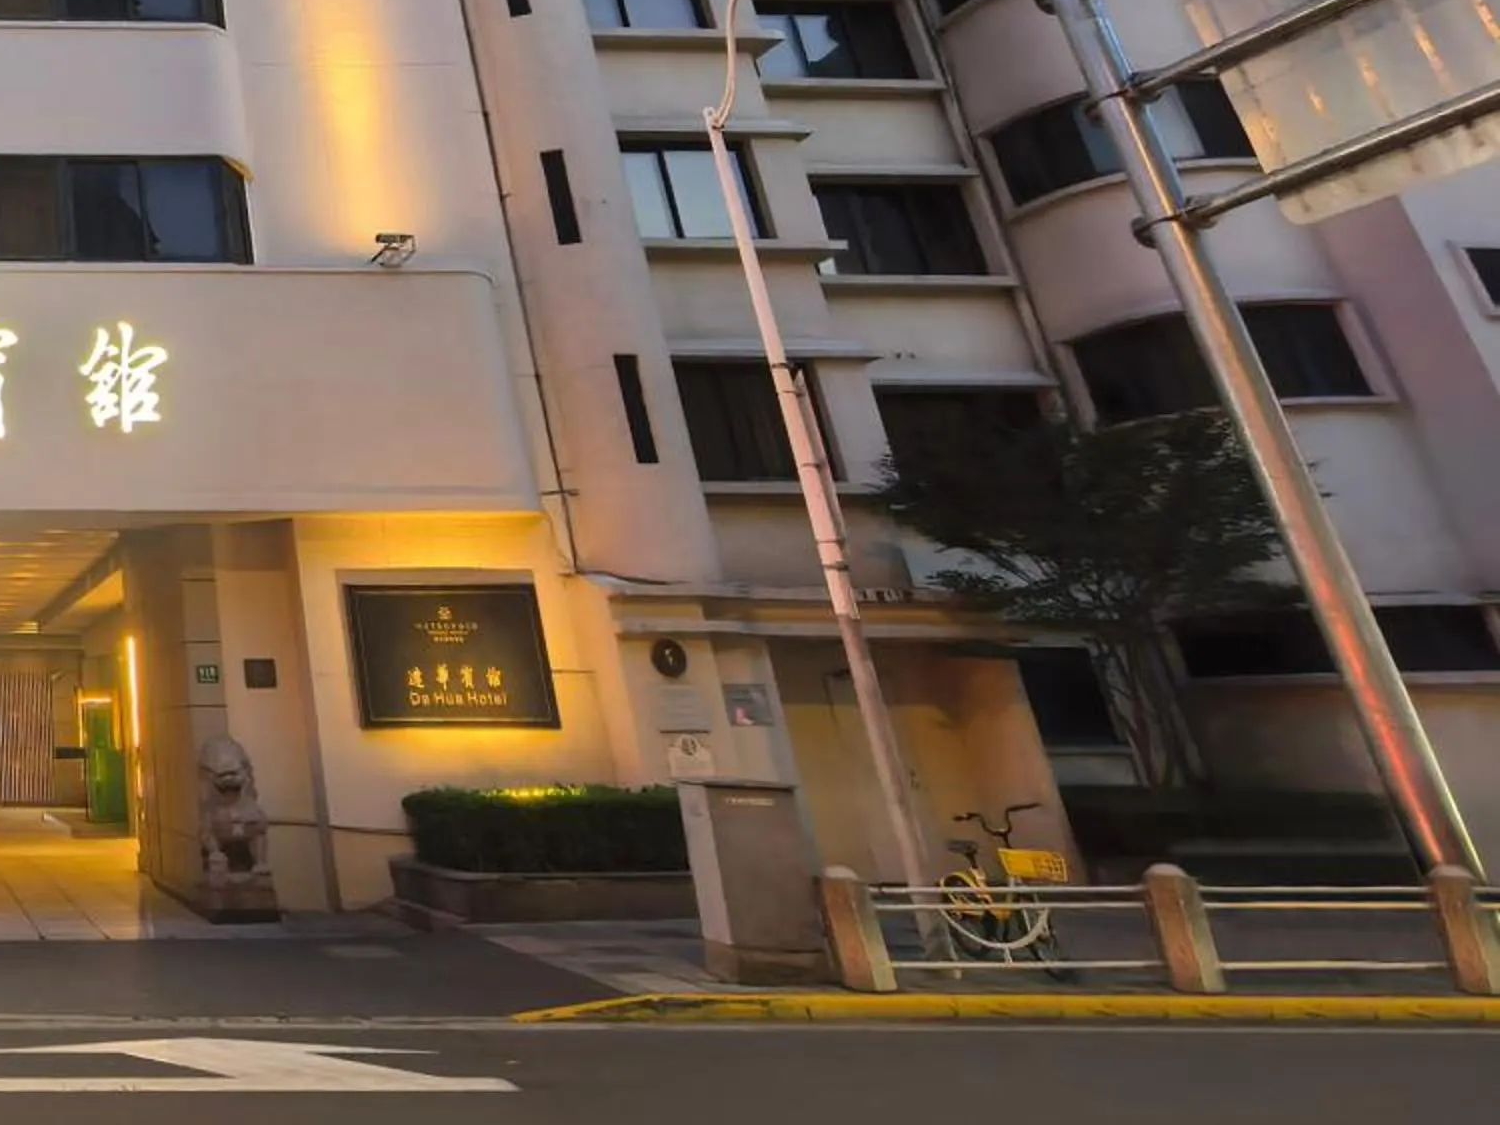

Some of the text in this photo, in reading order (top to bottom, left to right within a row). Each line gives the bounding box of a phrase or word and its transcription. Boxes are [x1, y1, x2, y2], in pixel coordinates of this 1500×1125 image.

[409, 691, 508, 707] Da Hua Hotel
